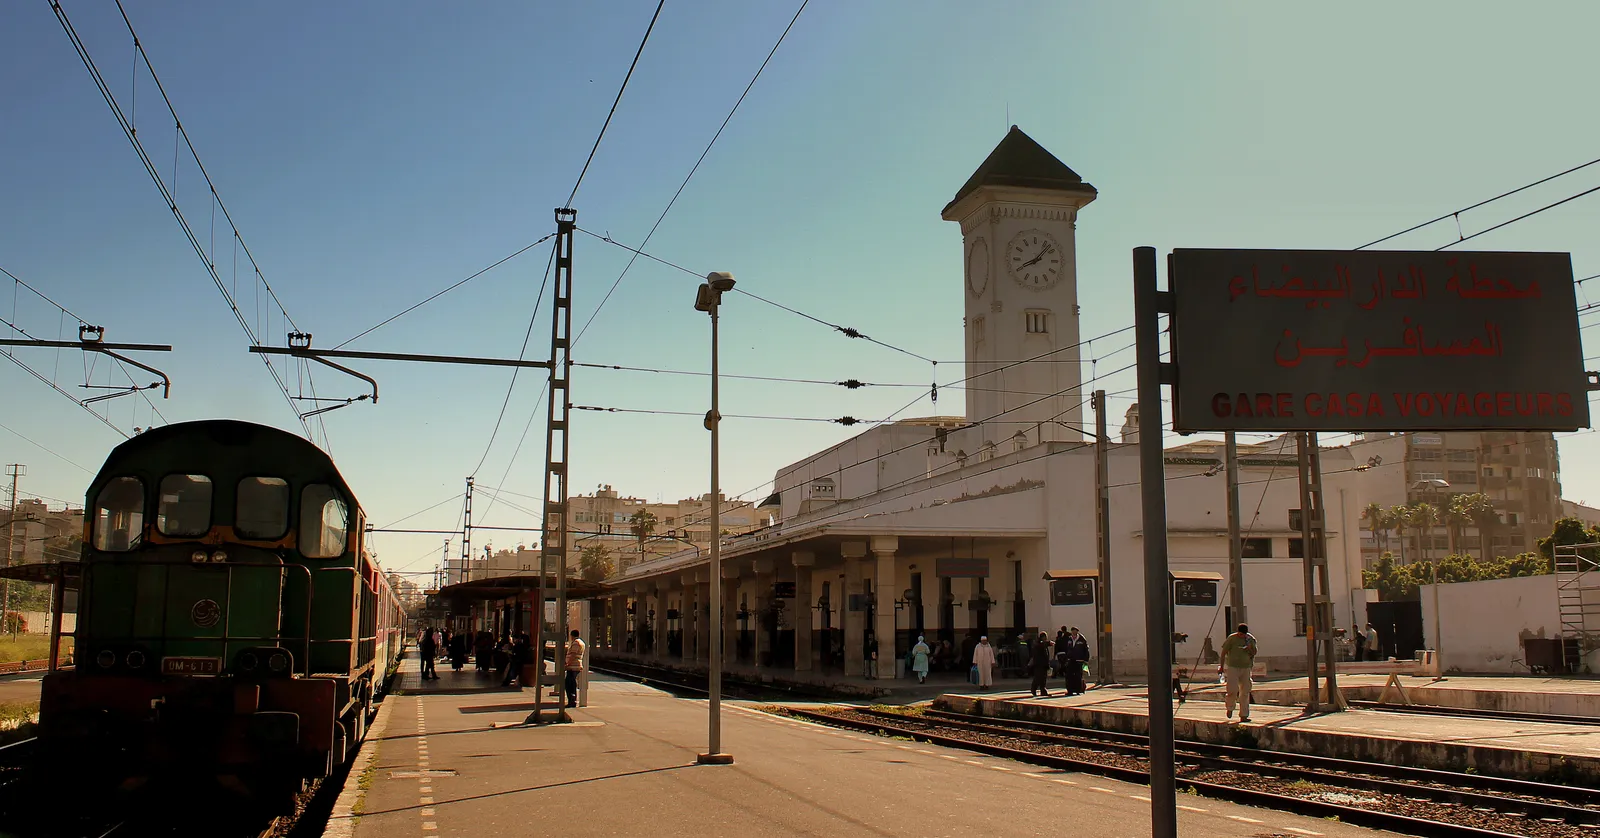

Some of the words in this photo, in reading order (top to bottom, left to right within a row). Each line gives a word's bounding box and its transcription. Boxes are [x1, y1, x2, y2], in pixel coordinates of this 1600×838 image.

[1229, 264, 1352, 308] البيضاء
[1361, 265, 1427, 310] الدار
[1446, 257, 1543, 299] محطة
[1275, 317, 1504, 368] المسافرين
[1213, 392, 1294, 418] GARE
[1304, 391, 1386, 417] CASA
[1393, 391, 1574, 417] VOYAGEURS
